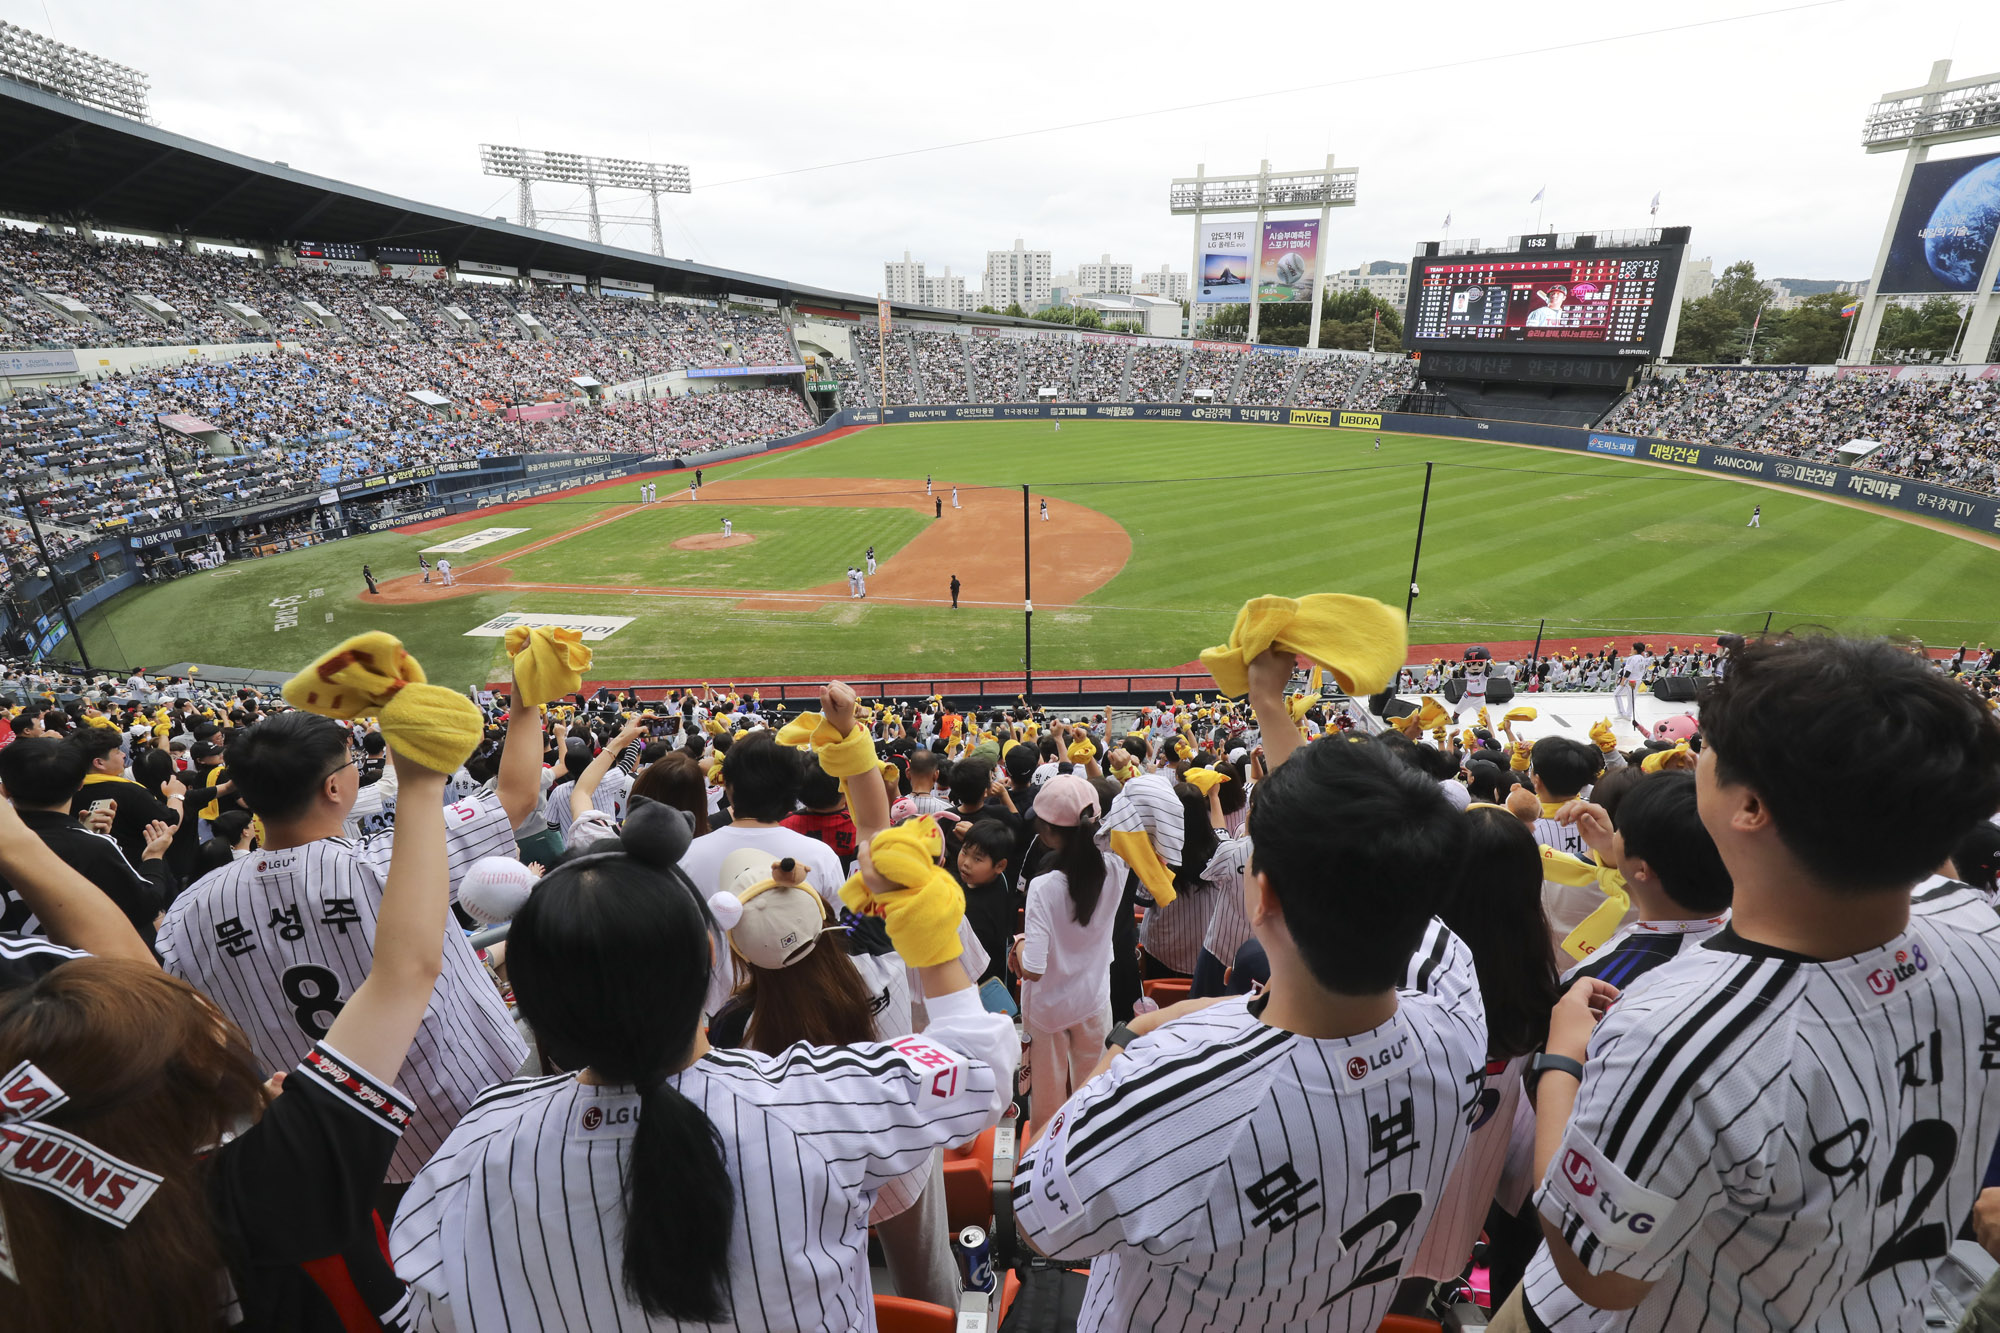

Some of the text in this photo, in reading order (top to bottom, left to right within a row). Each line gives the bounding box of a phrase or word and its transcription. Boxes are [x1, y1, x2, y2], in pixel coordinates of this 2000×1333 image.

[1211, 232, 1244, 240] 압도적 1위
[1918, 227, 1946, 238] 내일의
[1268, 241, 1288, 249] 스포키
[1527, 238, 1547, 248] 15:52
[1428, 354, 1512, 375] 한국경제신문
[1529, 360, 1623, 379] 한국경제TV
[1004, 408, 1040, 416] 한국경제신문
[1161, 408, 1182, 416] 비타란
[1205, 408, 1231, 419] 금강주택
[1240, 408, 1280, 421] 현대해상
[1340, 415, 1379, 427] UBORA
[1596, 440, 1635, 453] 도미노피자
[1649, 444, 1700, 465] 대방건설
[1714, 455, 1764, 472] HANCOM
[1794, 466, 1837, 488] 대보건설
[1848, 475, 1902, 500] 치킨마루
[1917, 492, 1976, 517] 한국경제TV
[143, 528, 182, 546] IBK 캐피탈
[268, 856, 297, 869] LG U+
[214, 898, 361, 958] 문성주
[280, 963, 345, 1041] 8
[1369, 1034, 1409, 1072] LG U+
[605, 1108, 631, 1126] LG
[0, 1123, 138, 1210] TWINS
[1040, 1143, 1054, 1180] LG
[1856, 1118, 1958, 1287] 2
[1598, 1191, 1656, 1234] tvG
[1311, 1190, 1426, 1315] 2
